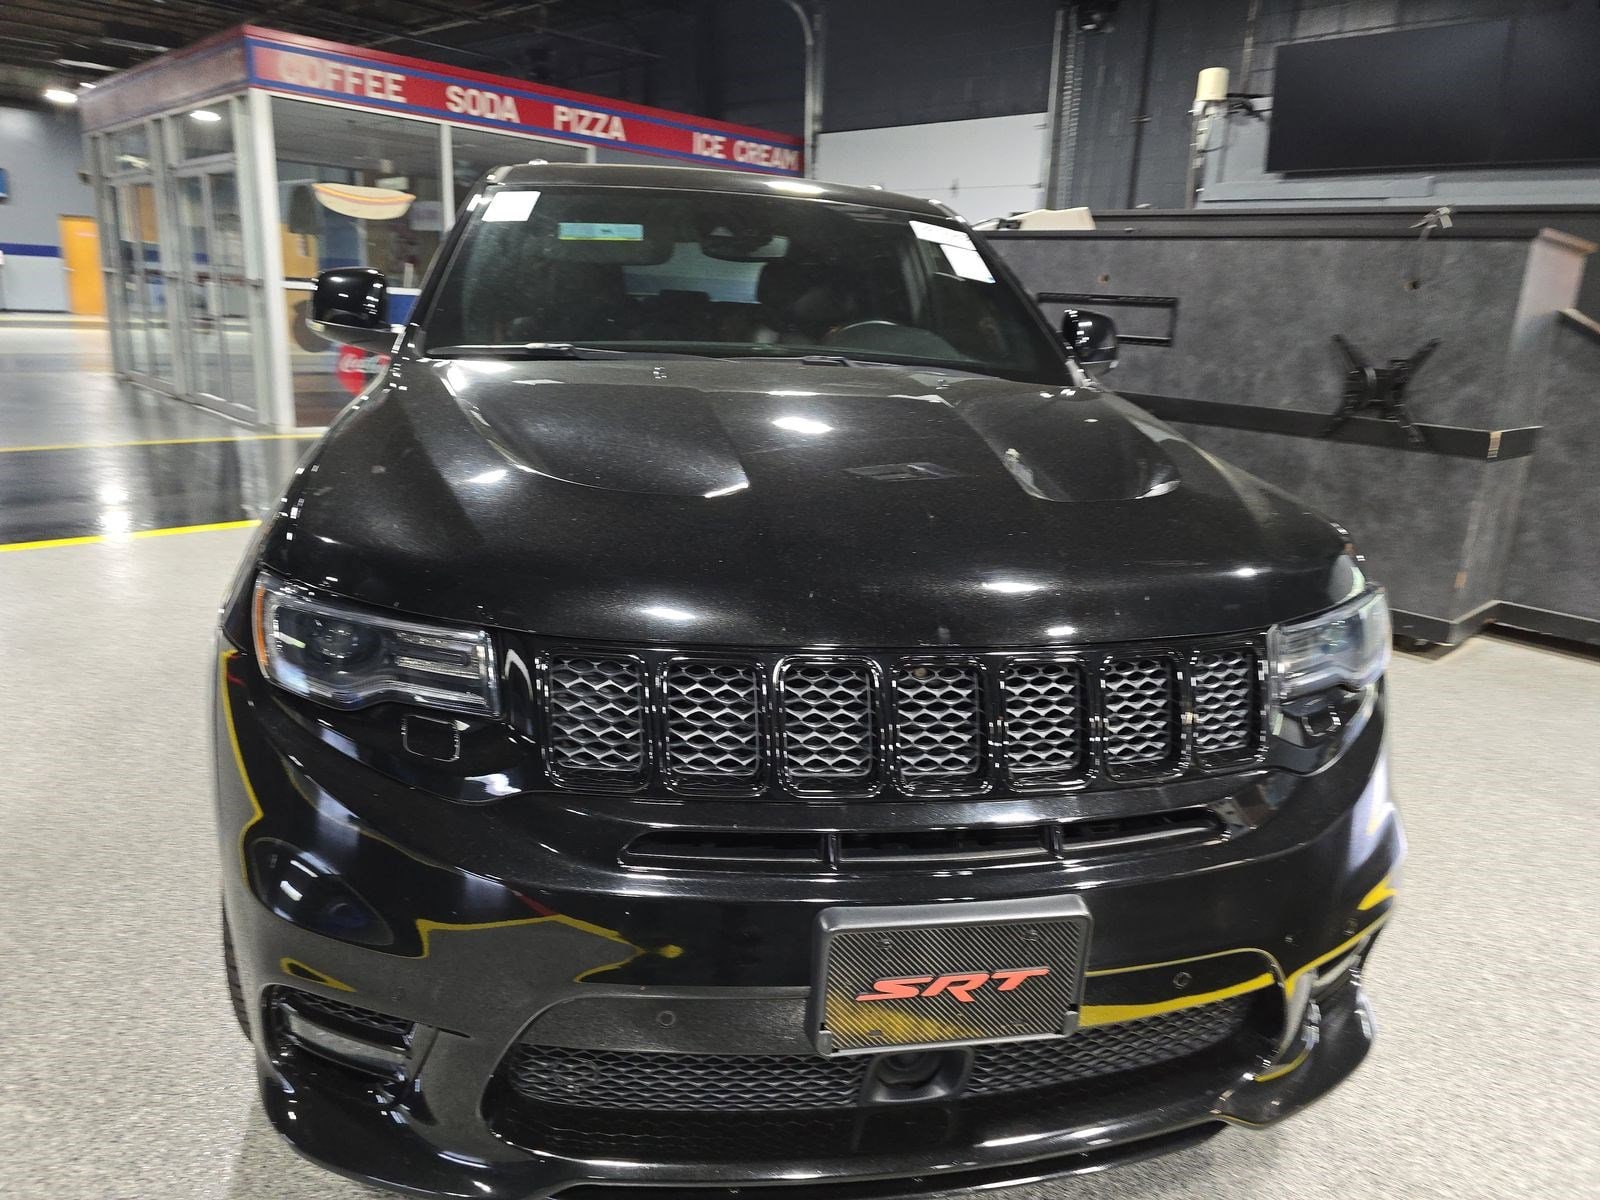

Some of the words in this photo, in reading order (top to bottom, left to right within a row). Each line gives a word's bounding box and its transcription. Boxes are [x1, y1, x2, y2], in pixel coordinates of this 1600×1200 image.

[277, 51, 407, 103] COFFEE
[445, 85, 521, 124] SODA
[553, 105, 627, 142] PIZZA
[692, 132, 727, 159] ICE
[732, 140, 800, 171] CREAM
[855, 966, 1050, 1003] SRT
